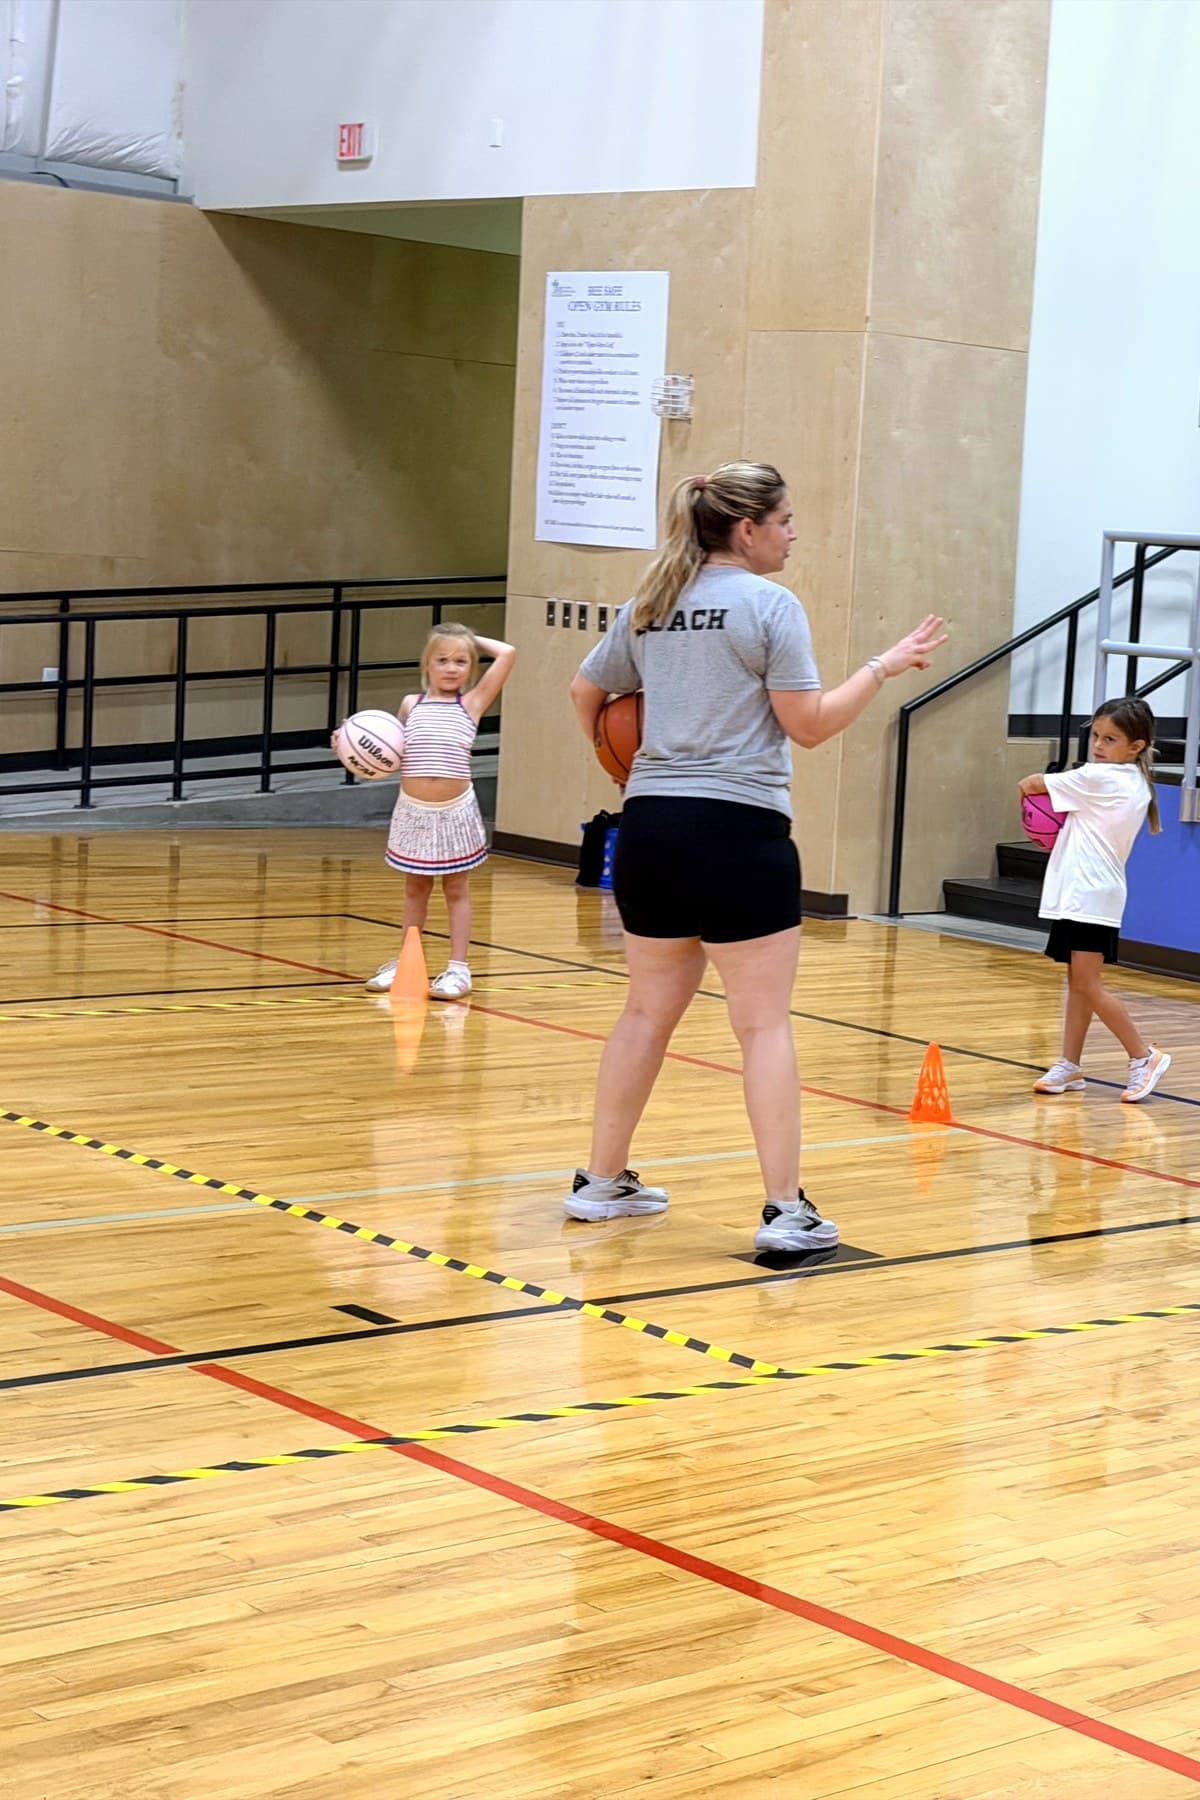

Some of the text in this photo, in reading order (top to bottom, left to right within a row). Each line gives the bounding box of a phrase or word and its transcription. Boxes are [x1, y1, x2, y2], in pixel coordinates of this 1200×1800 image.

[339, 123, 364, 157] EXIT
[636, 608, 729, 636] ACH
[358, 735, 394, 768] Wilson
